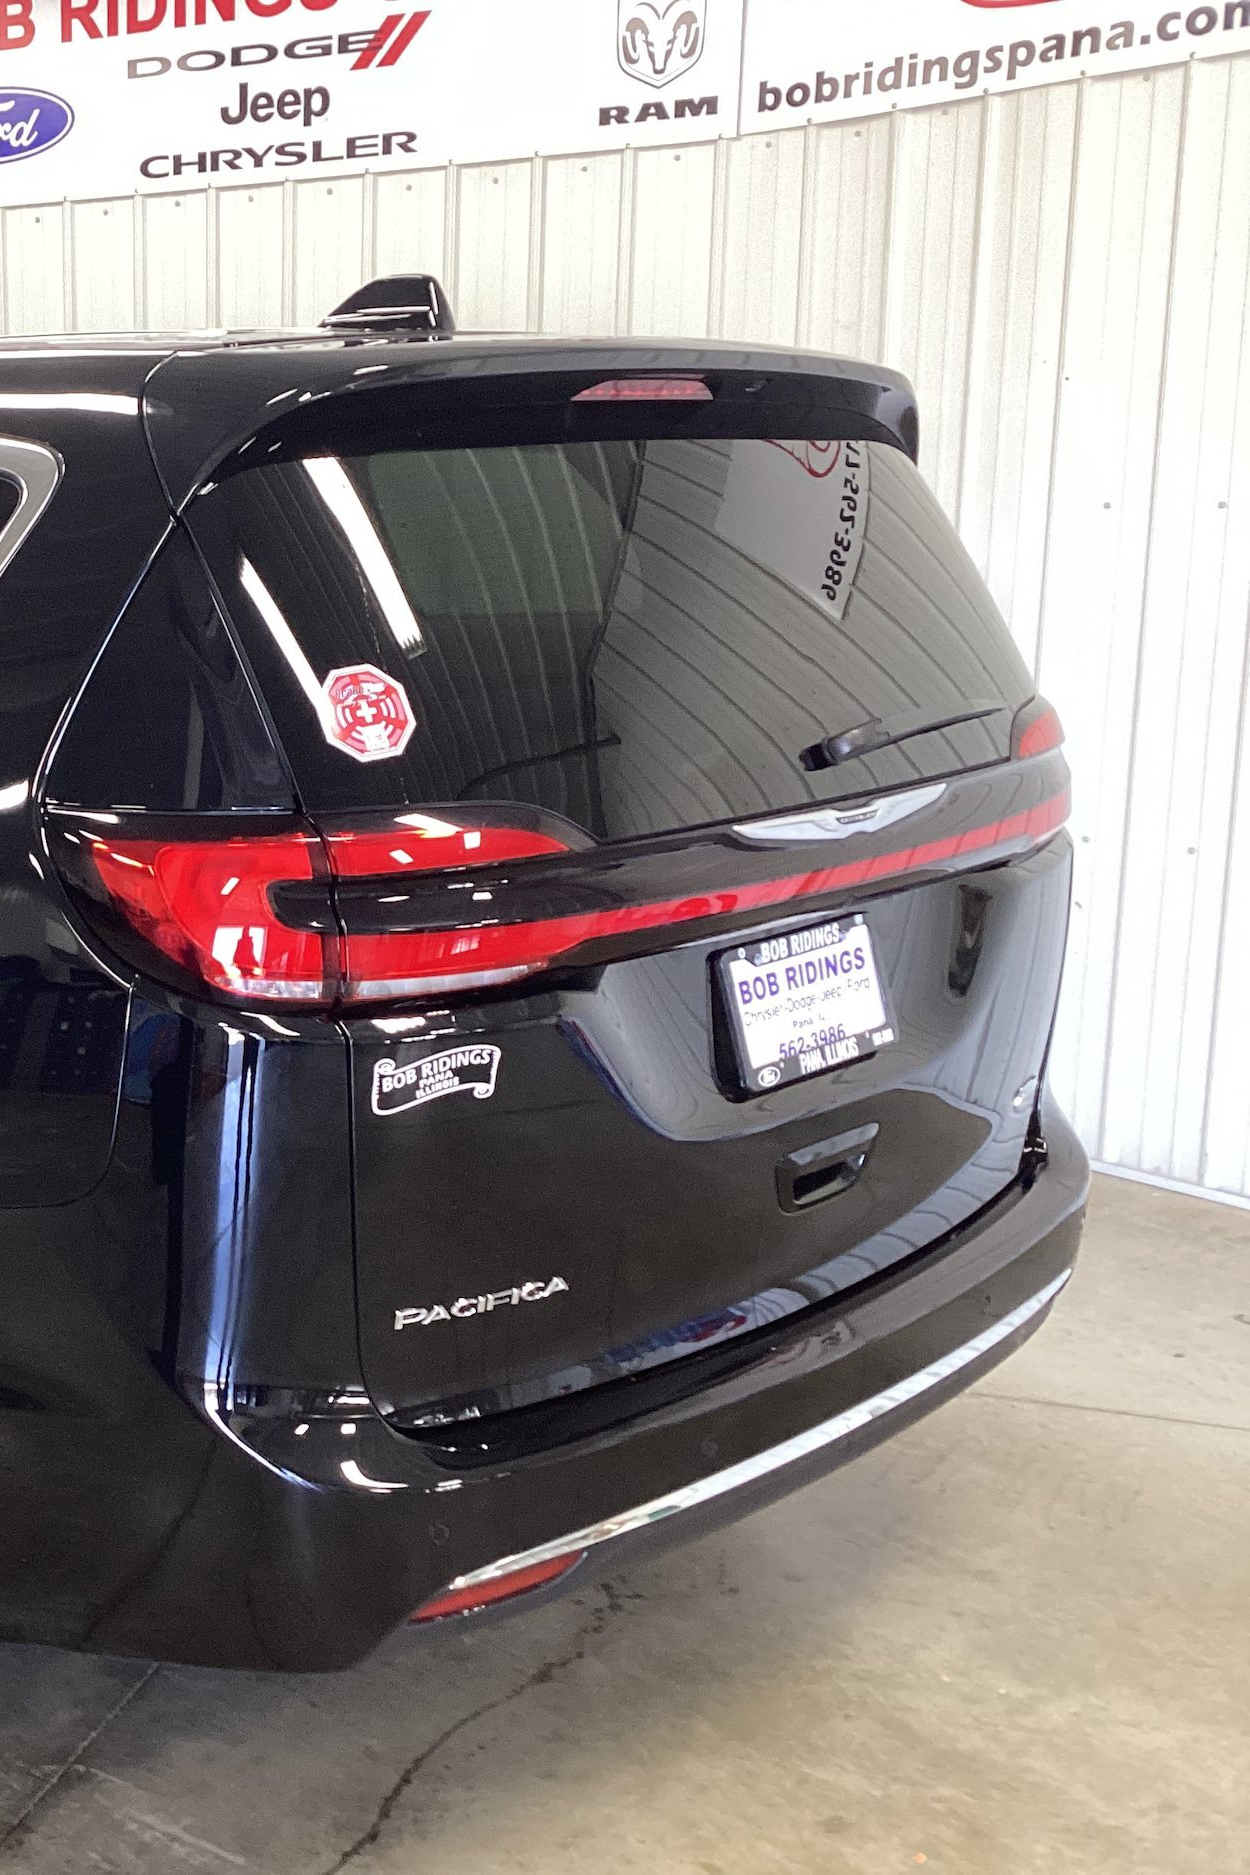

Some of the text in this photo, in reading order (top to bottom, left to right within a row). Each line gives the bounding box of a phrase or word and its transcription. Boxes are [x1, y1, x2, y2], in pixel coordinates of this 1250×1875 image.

[61, 0, 340, 43] RIDI
[127, 29, 384, 79] DODGE
[221, 82, 330, 127] Jeep
[598, 95, 719, 126] RAM
[139, 131, 418, 179] CHRYSLER
[760, 922, 840, 963] BOB RIDINGS
[738, 947, 866, 1005] BOB RIDINGS
[382, 1049, 492, 1093] BOB RIDINGS
[416, 1077, 460, 1099] ILLINOIS
[419, 1070, 454, 1088] PANA
[394, 1276, 569, 1330] PACIFICA
